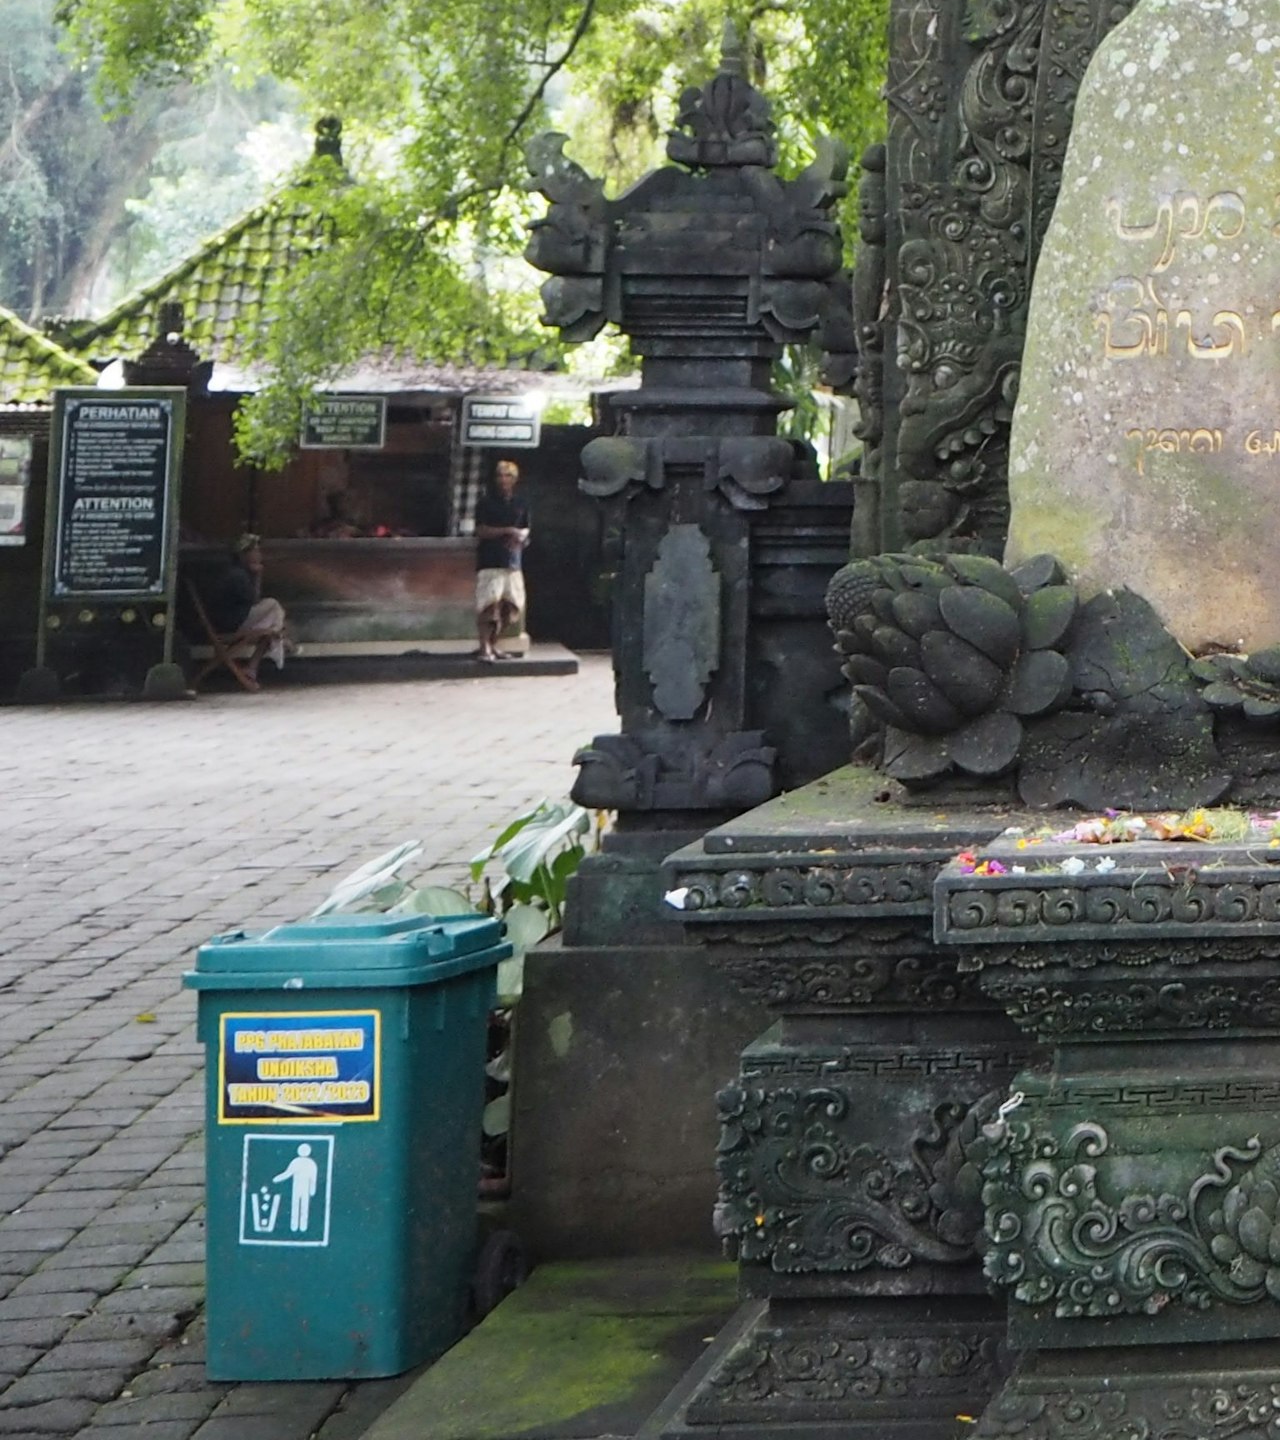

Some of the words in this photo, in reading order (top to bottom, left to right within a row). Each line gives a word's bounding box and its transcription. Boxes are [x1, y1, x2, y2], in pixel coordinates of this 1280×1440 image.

[79, 407, 160, 420] PERHATIAN
[73, 497, 154, 511] ATTENTION
[236, 1032, 266, 1052] PPG
[260, 1057, 336, 1079] UNDIKSHA
[230, 1084, 278, 1105] TAHUN
